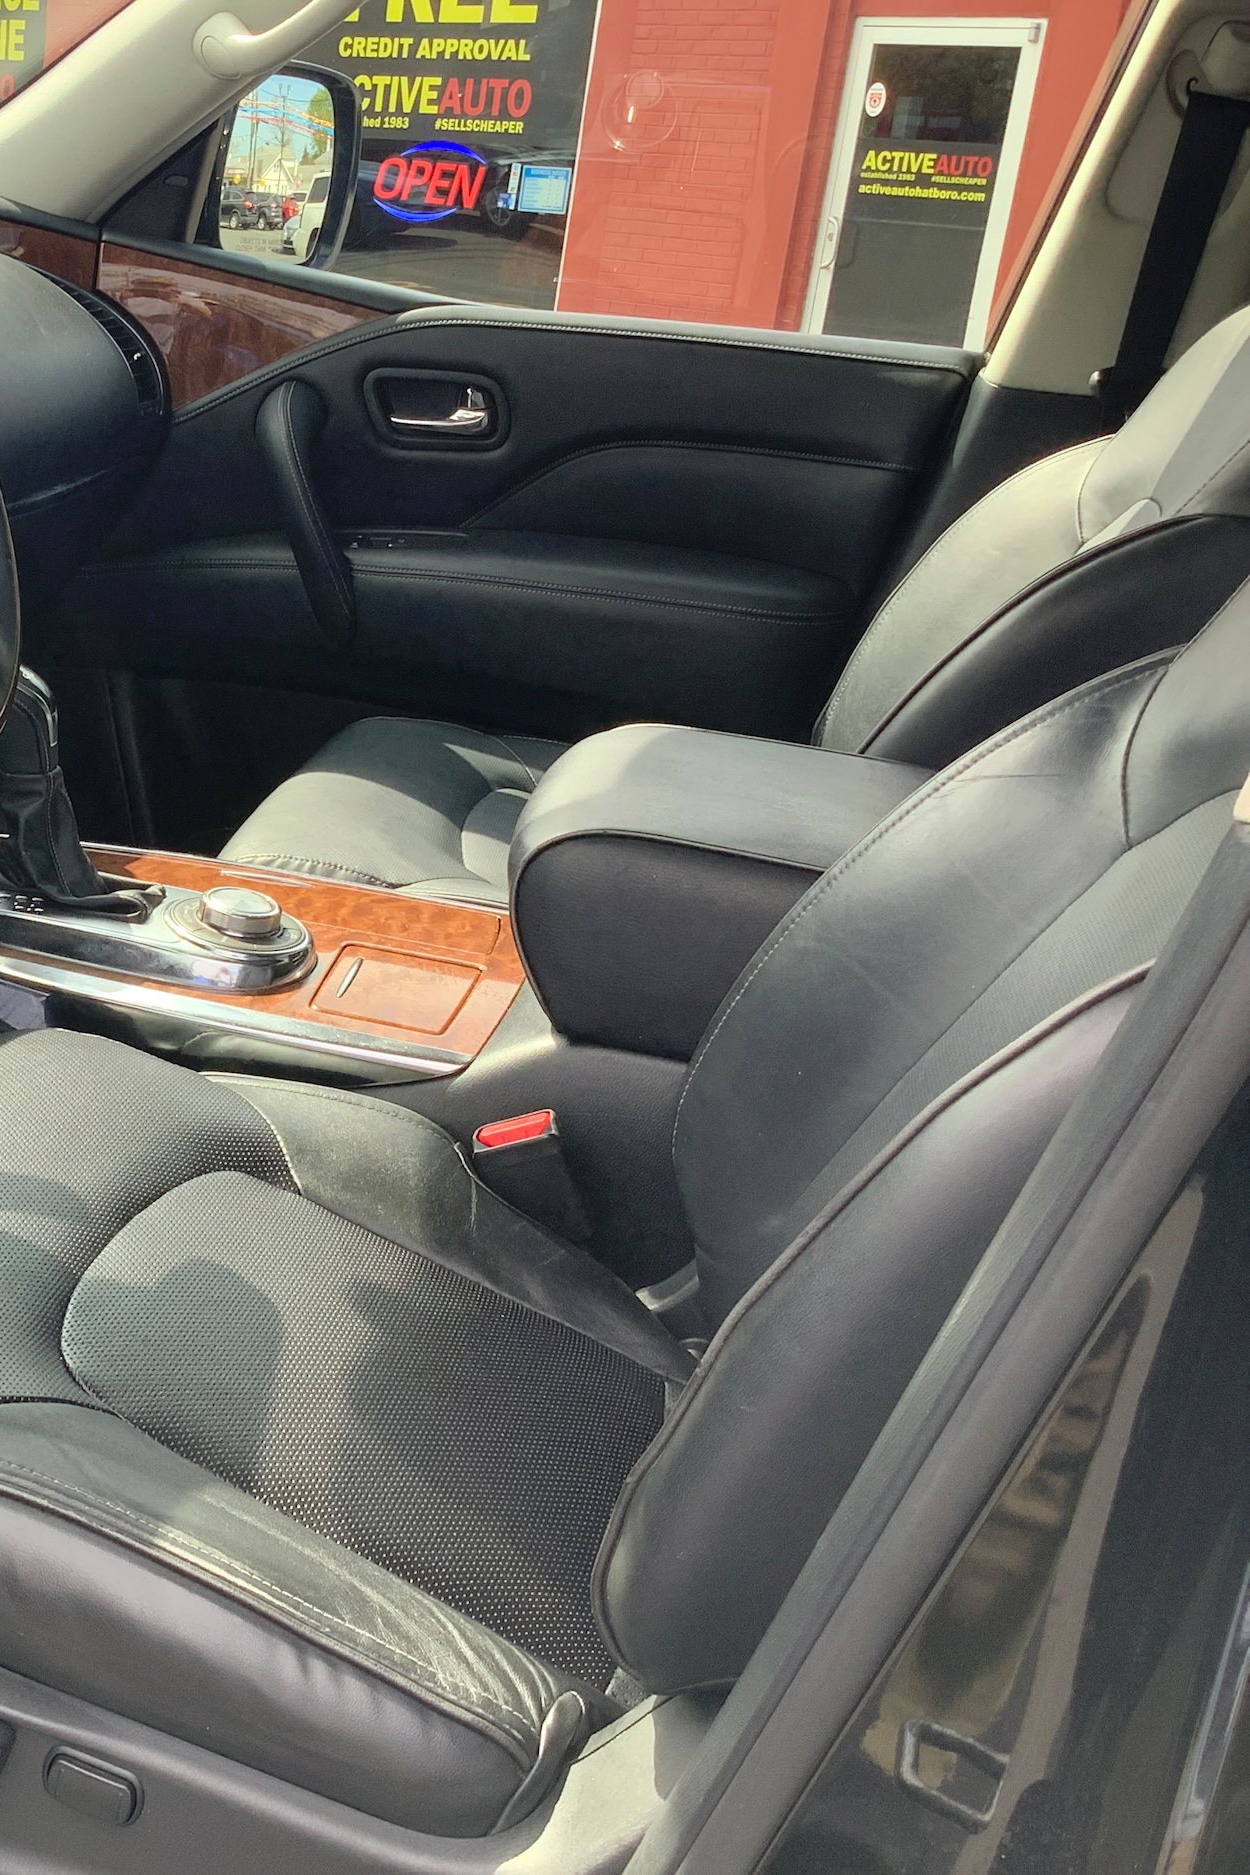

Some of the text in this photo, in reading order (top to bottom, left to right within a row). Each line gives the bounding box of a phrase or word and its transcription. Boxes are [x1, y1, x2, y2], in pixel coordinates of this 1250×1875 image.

[338, 36, 532, 61] CREDIT APPROVAL
[353, 74, 533, 118] CTIVEAUTO
[383, 117, 410, 129] 1983
[434, 118, 524, 134] #SELLSCHEAPER
[861, 150, 993, 177] ACTIVEAUTO
[373, 156, 487, 209] OPEN
[858, 183, 986, 202] activeautohatboro.com
